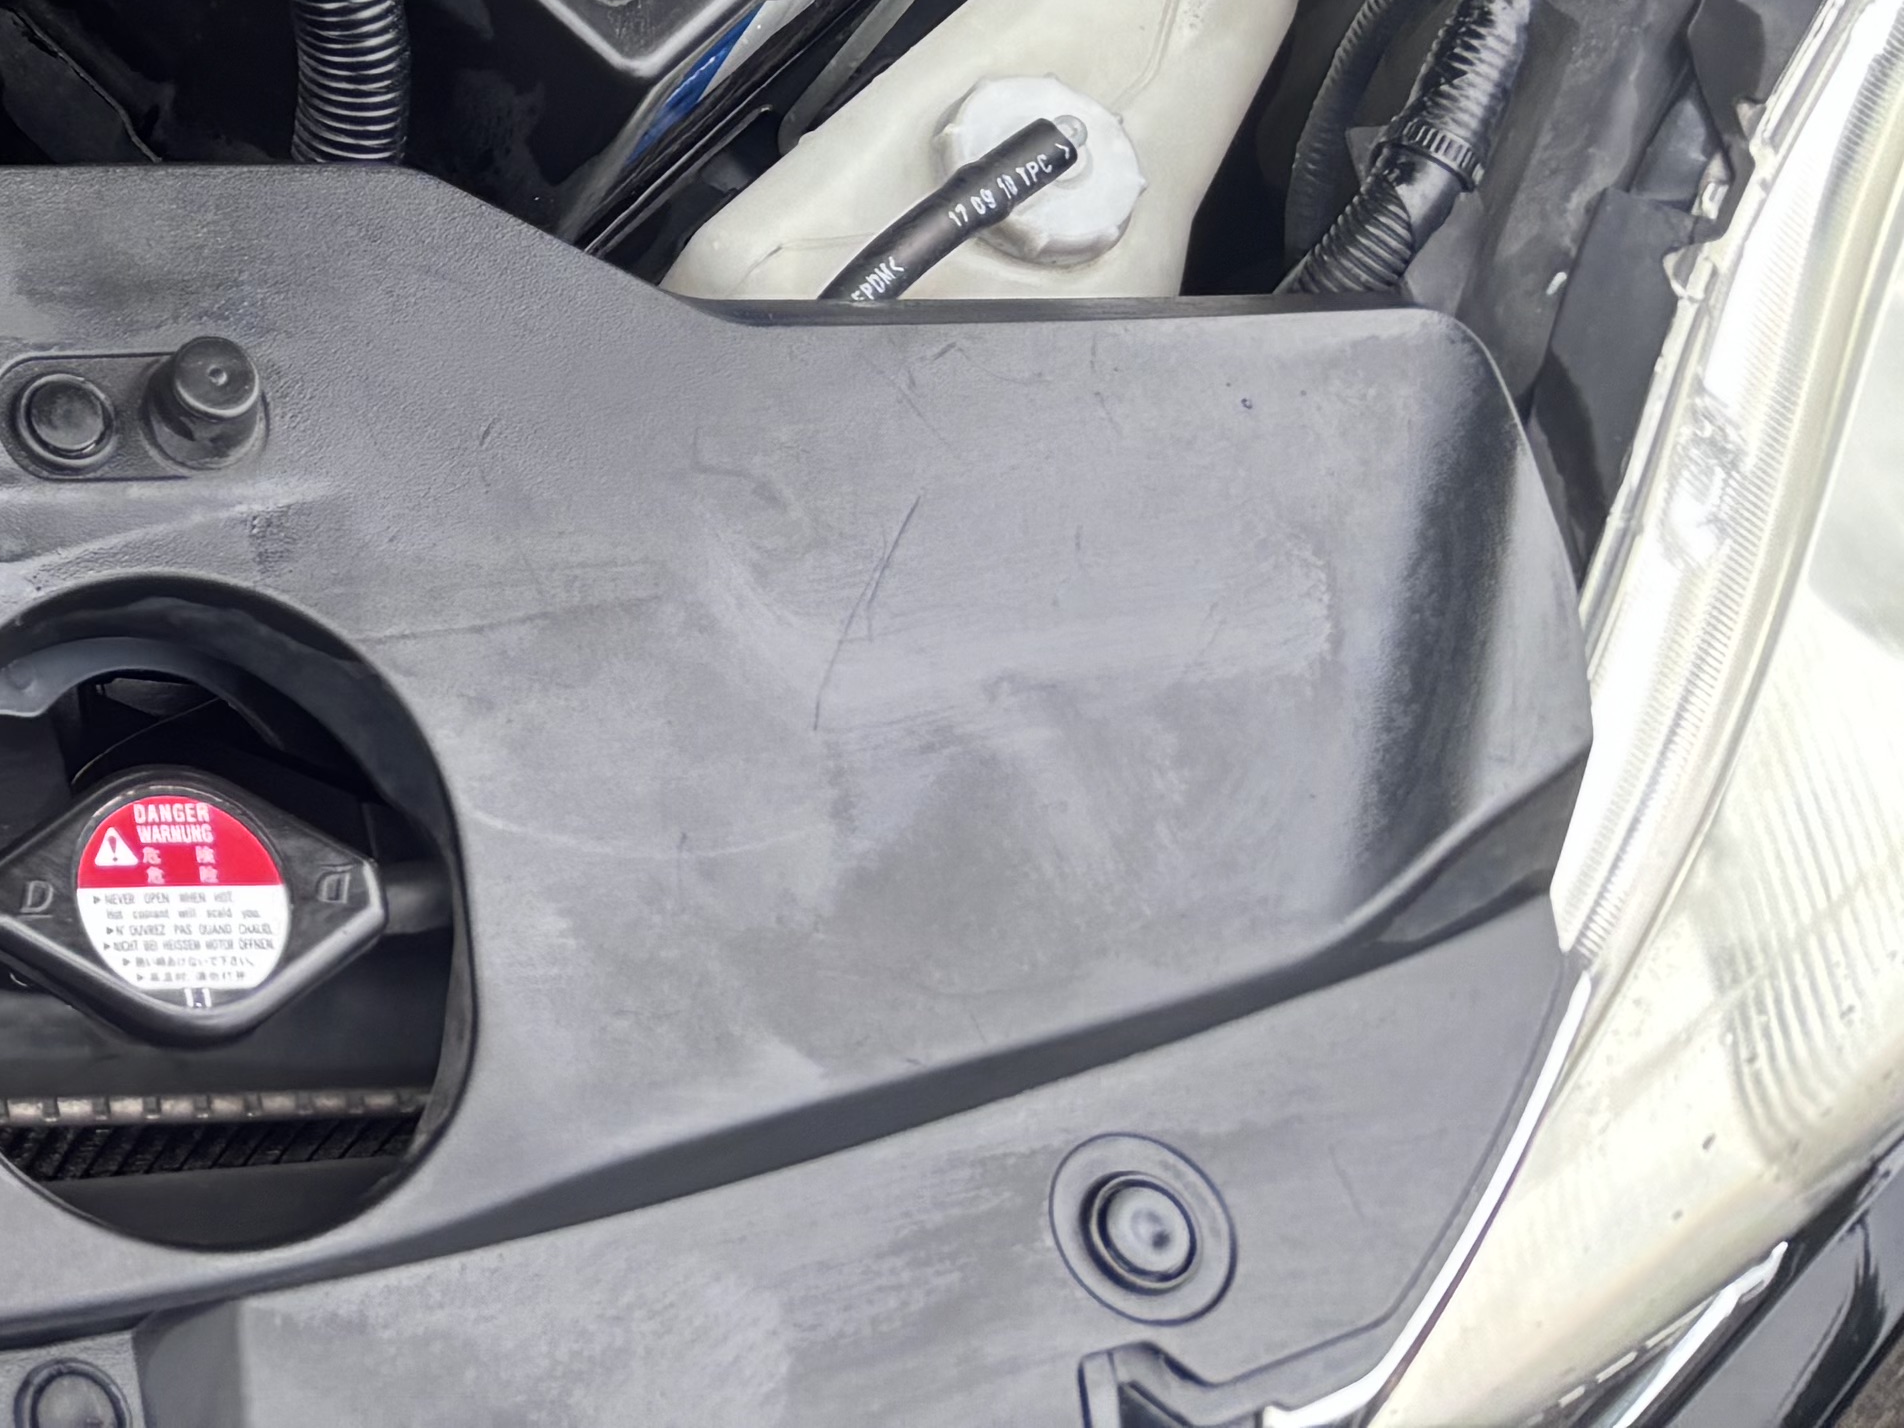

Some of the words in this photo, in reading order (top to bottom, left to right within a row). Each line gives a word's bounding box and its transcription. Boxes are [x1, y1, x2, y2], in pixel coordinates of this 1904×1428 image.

[1015, 154, 1053, 186] TPC
[133, 803, 209, 823] DANGER
[136, 824, 214, 843] WARNUNG
[105, 893, 135, 905] NEVER
[144, 893, 170, 904] OPEN
[179, 892, 207, 903] WHEN
[207, 908, 232, 918] scald
[129, 925, 165, 936] OUVREZ
[174, 925, 192, 935] PAS
[199, 924, 232, 935] QUAND
[205, 940, 234, 950] MOTOR
